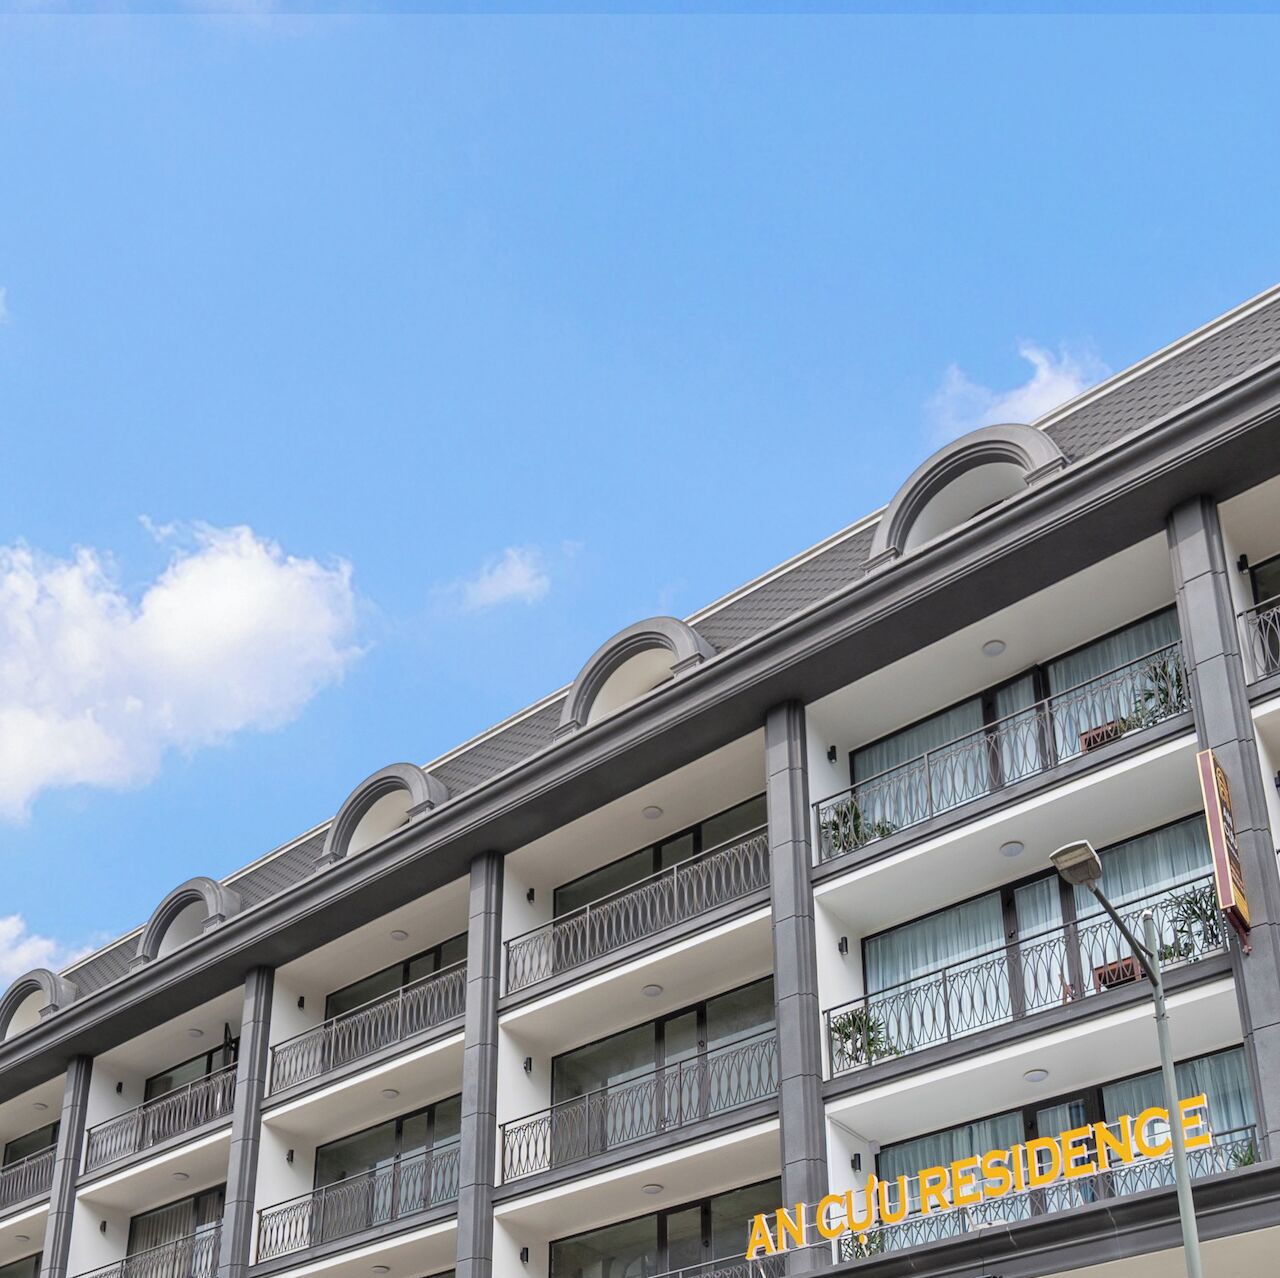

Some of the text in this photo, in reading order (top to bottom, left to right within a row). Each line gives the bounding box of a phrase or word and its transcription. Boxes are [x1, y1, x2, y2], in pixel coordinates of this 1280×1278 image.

[745, 1093, 1212, 1260] AN CỰU RESIDENCE
